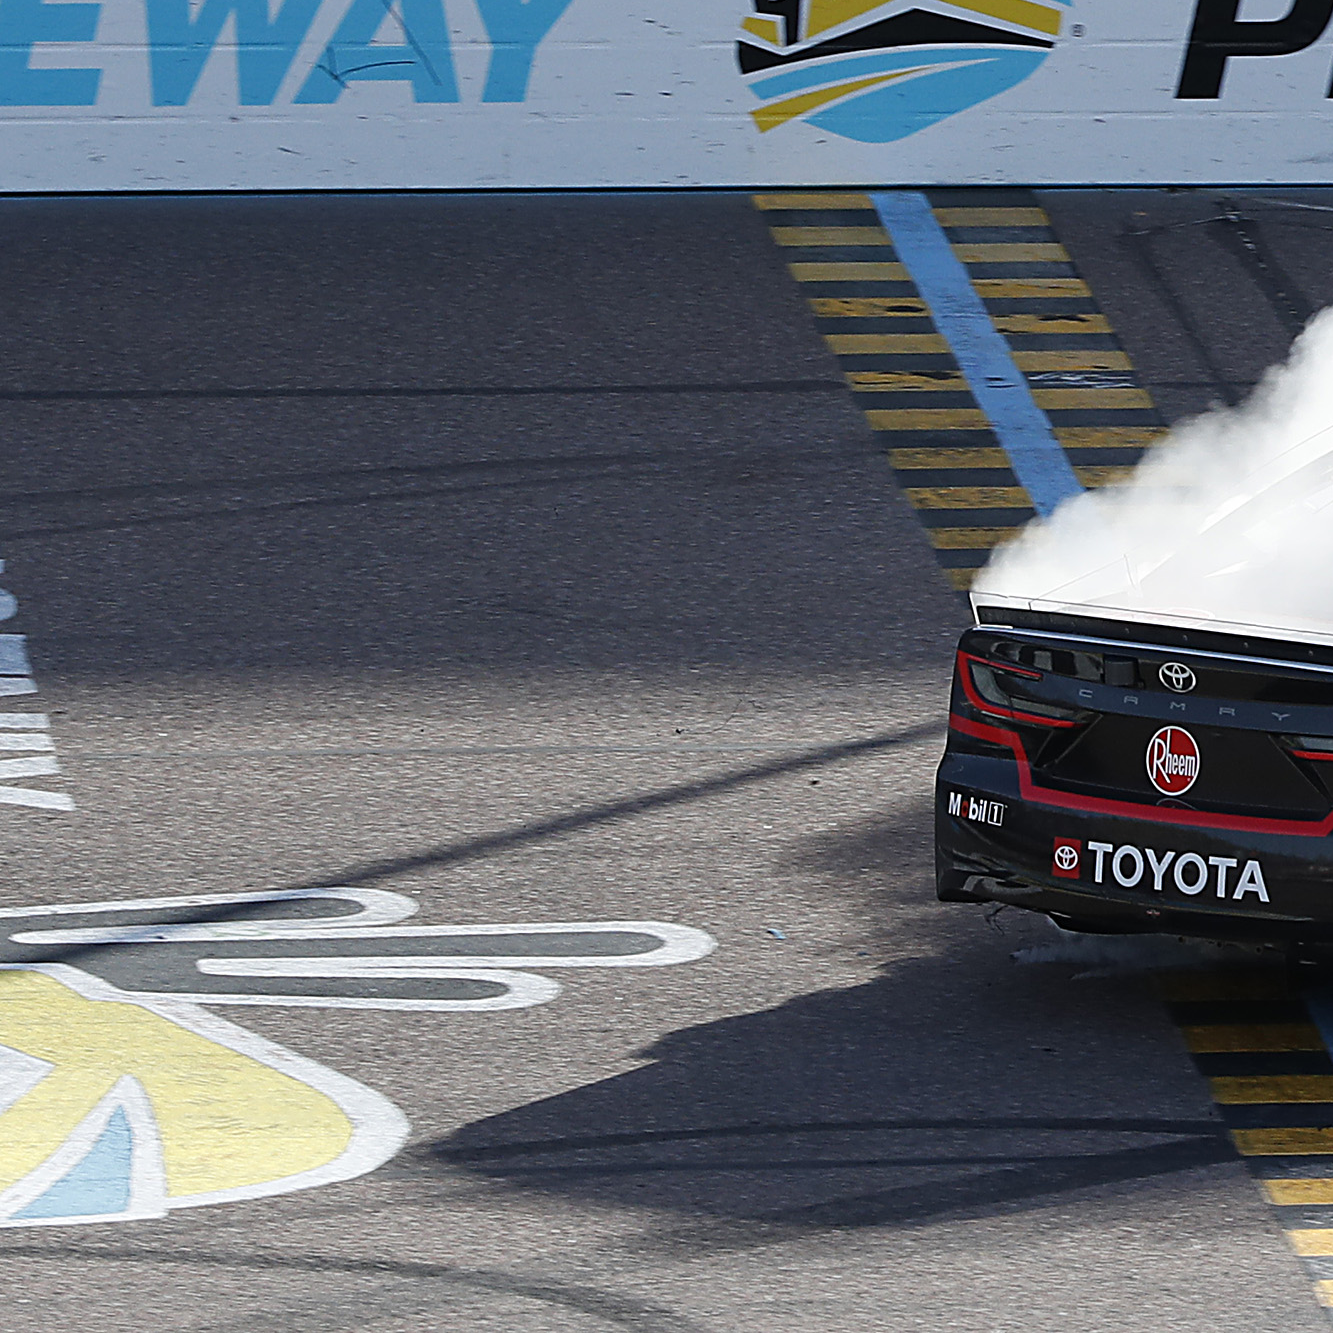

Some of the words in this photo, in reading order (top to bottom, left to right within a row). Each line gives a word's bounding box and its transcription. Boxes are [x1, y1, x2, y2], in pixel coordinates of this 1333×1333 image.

[1078, 688, 1292, 722] CAMRY
[1152, 728, 1196, 784] Rheem
[948, 792, 988, 823] Mobil
[1088, 841, 1270, 903] TOYOTA
